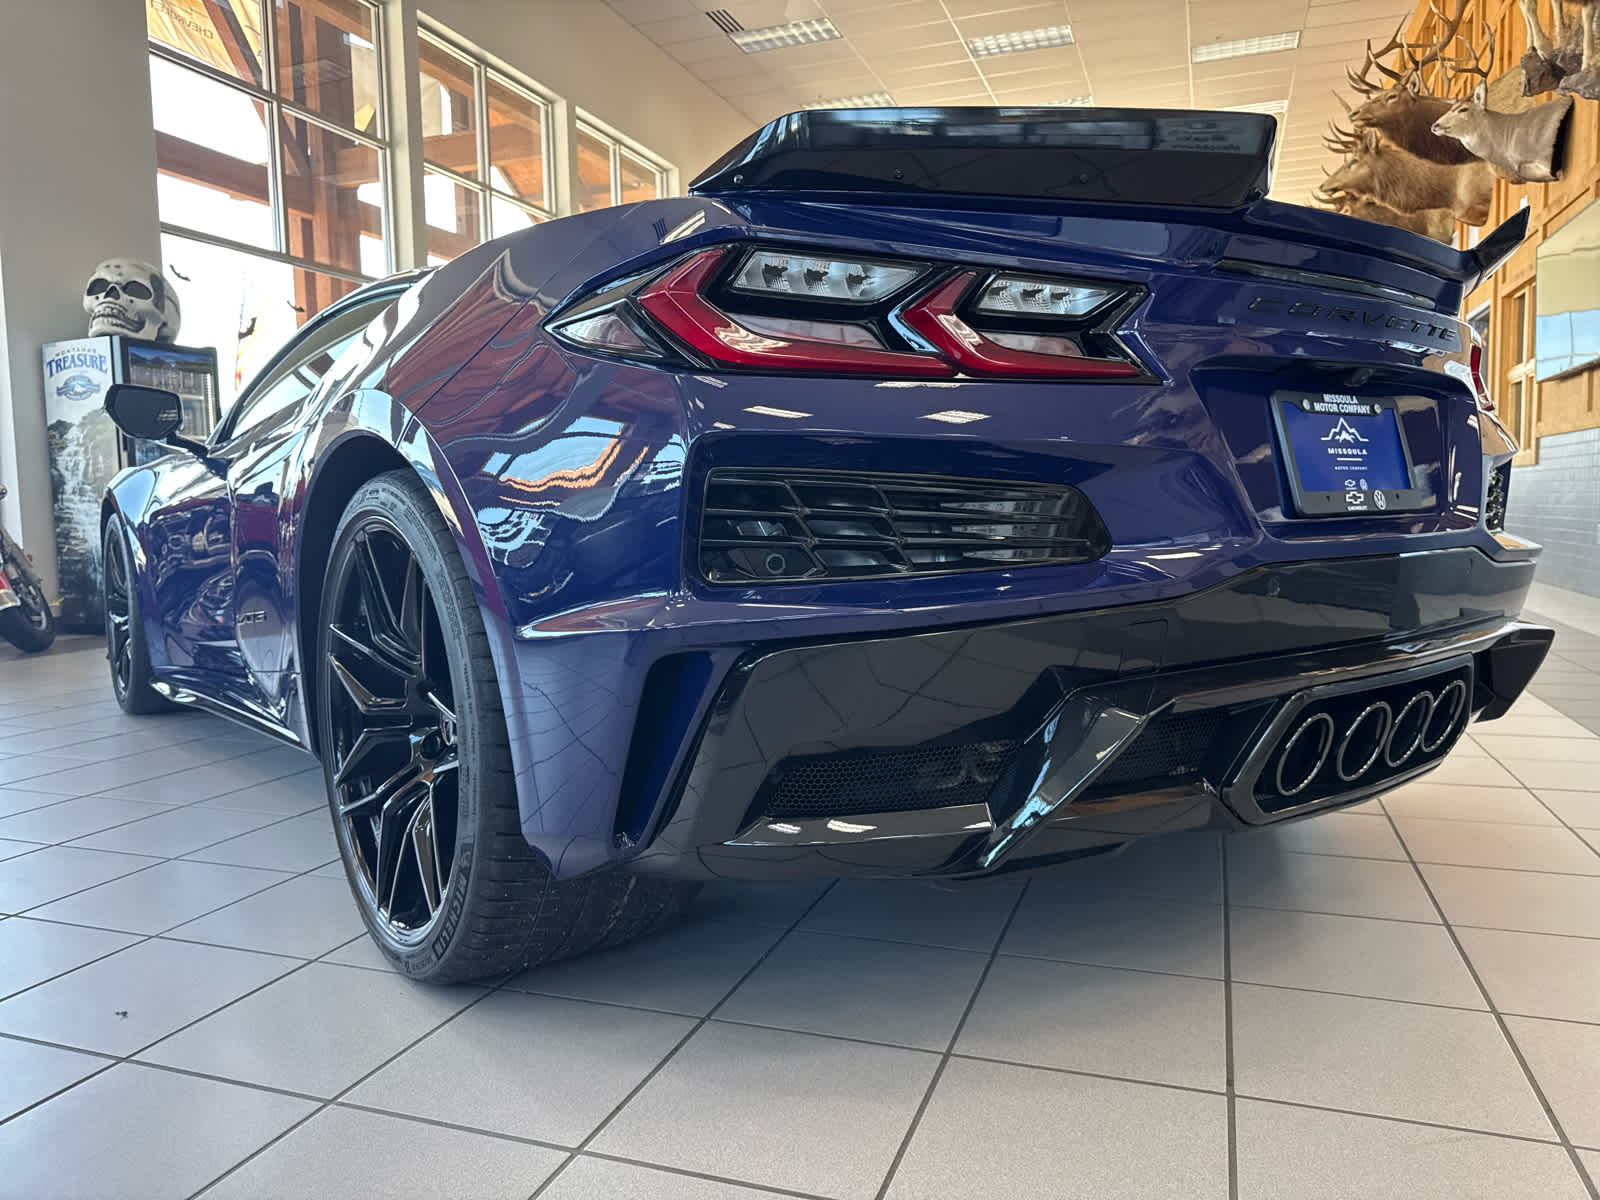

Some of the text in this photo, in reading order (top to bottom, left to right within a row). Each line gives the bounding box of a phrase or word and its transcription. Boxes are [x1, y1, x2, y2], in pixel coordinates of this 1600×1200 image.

[1248, 297, 1457, 341] CORVETTE
[47, 352, 108, 378] TREASURE
[1313, 402, 1371, 414] MOTOR COMPANY
[1322, 393, 1359, 404] MISSOULA
[1327, 447, 1368, 455] MISSOULA
[433, 872, 468, 957] MICHELIN
